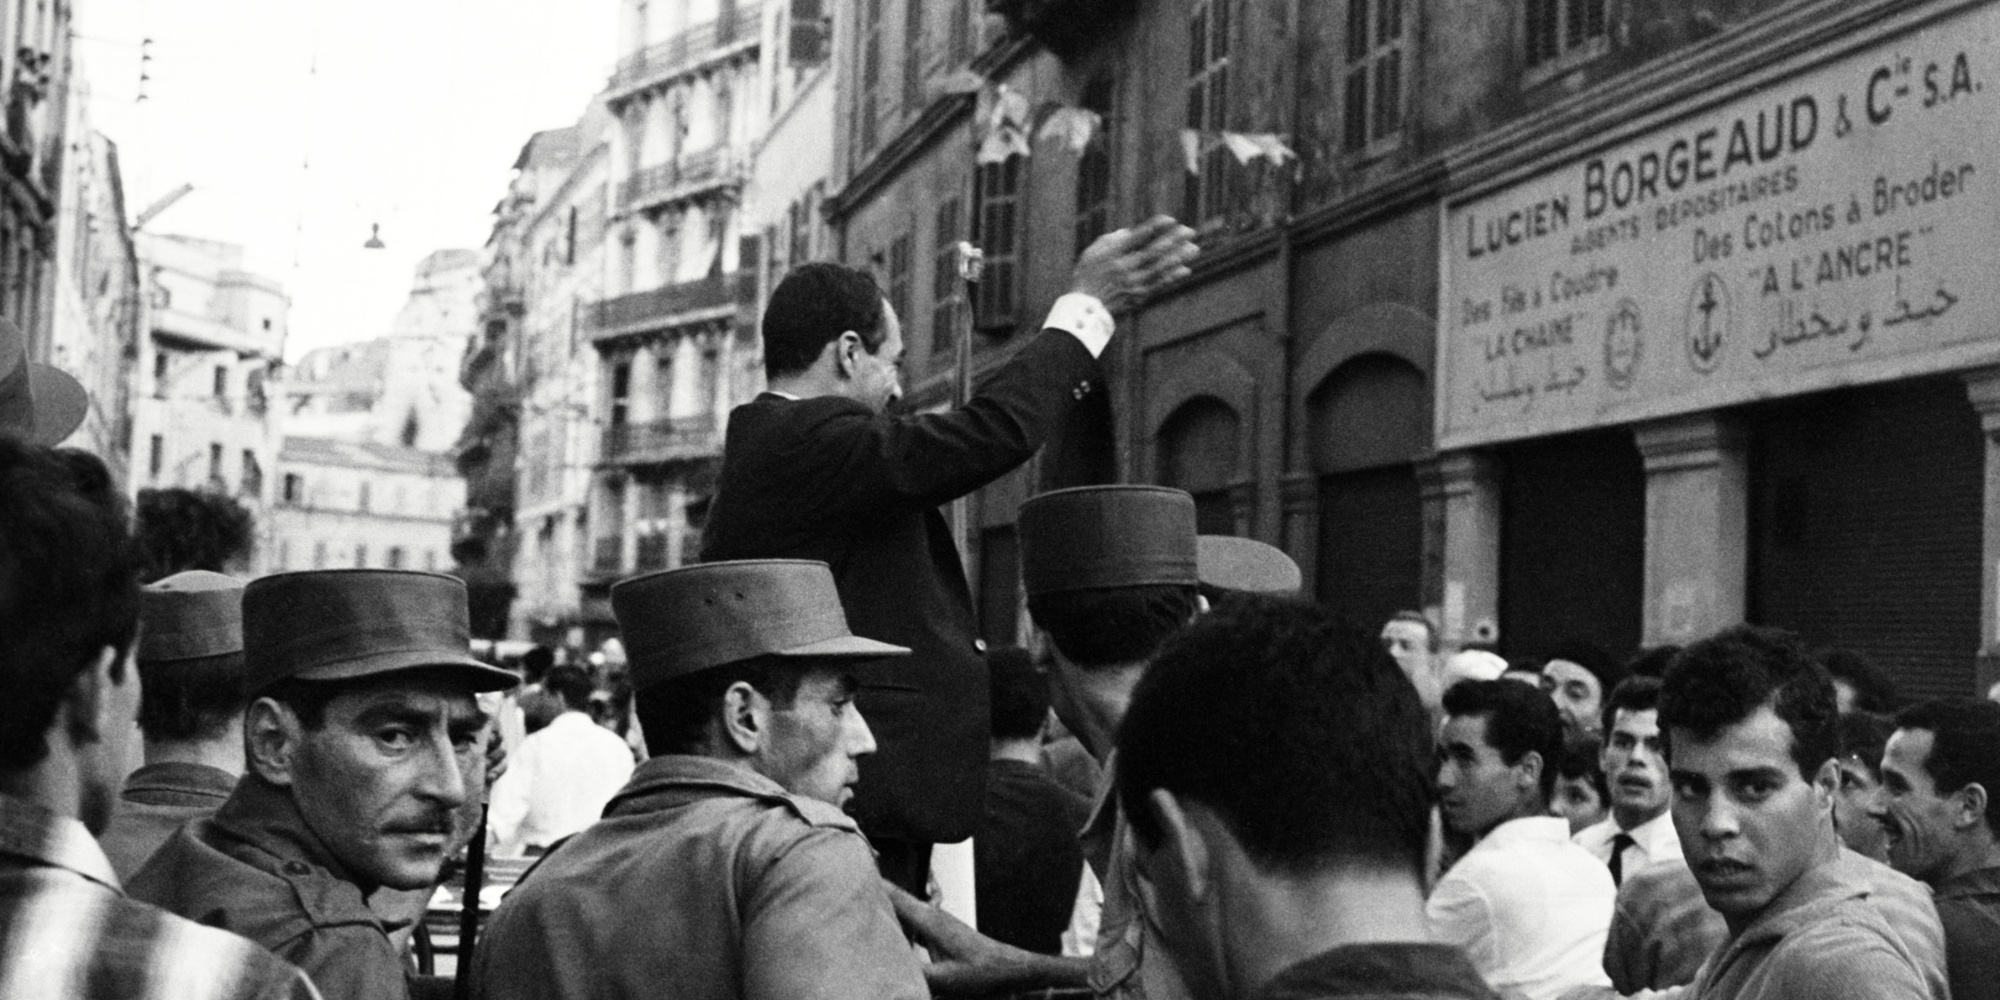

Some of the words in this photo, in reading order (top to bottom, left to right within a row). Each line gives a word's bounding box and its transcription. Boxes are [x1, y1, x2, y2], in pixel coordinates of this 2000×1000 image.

[1466, 195, 1569, 259] LUCIEN
[1584, 95, 1818, 221] BORGEAUD
[1835, 94, 1851, 138] &
[1924, 52, 1982, 107] S.A.
[1694, 228, 1732, 263] Des
[1745, 203, 1834, 251] Cotons
[1874, 160, 1975, 216] Broder
